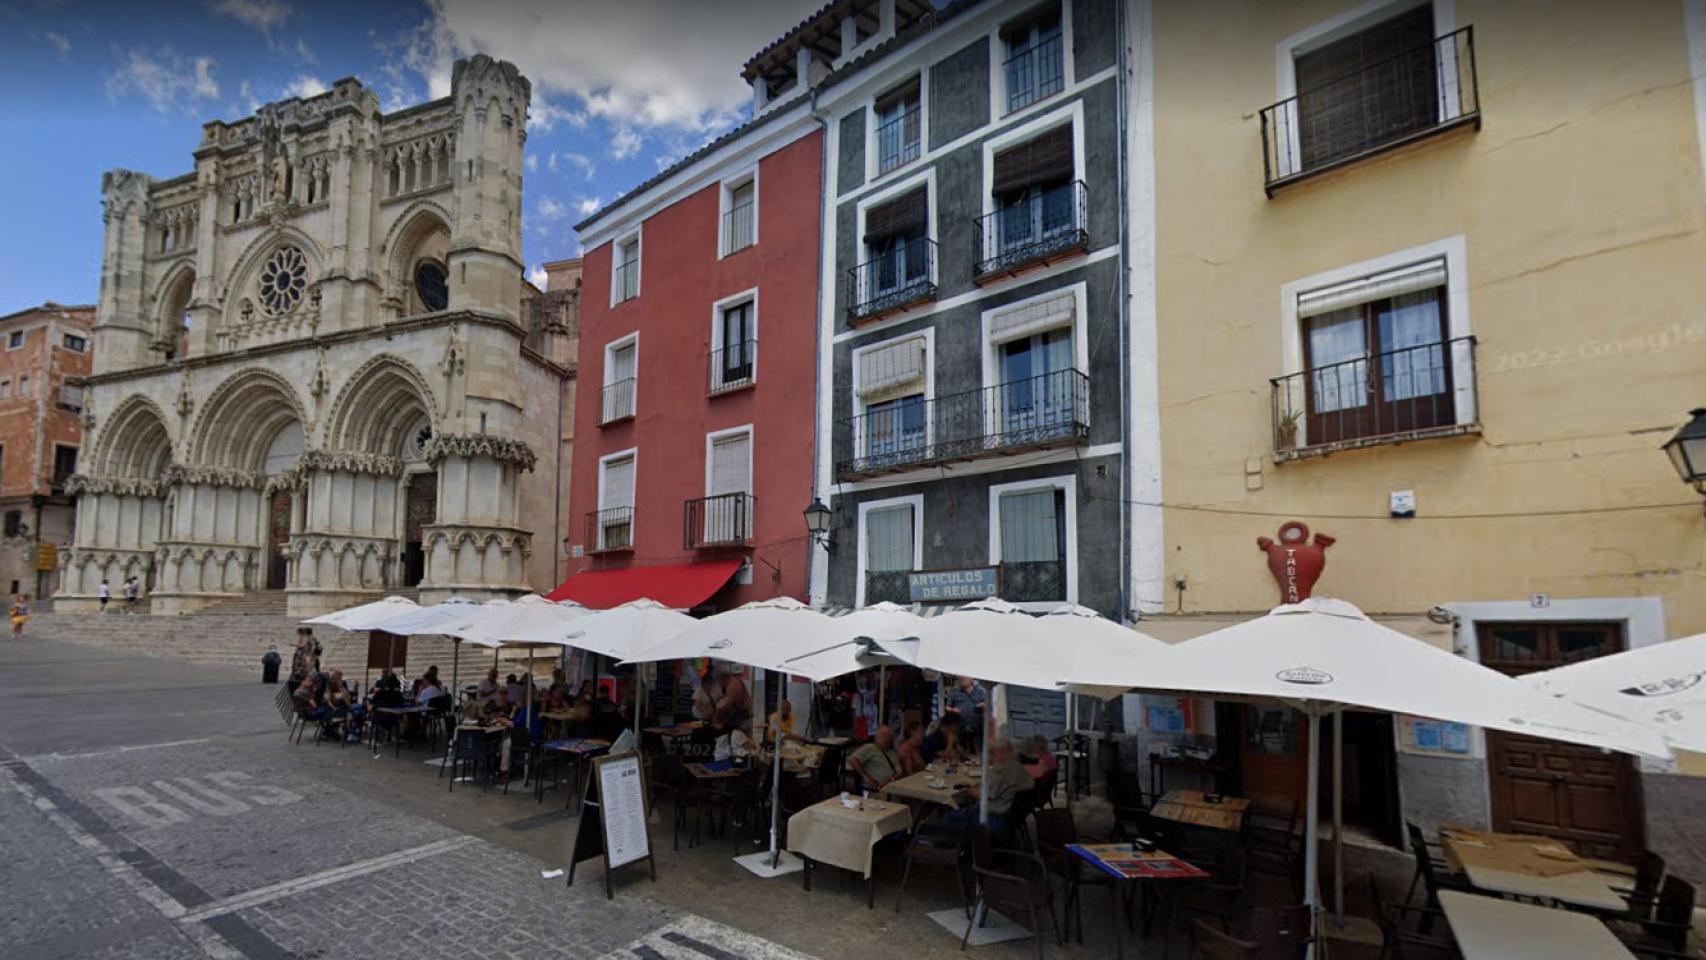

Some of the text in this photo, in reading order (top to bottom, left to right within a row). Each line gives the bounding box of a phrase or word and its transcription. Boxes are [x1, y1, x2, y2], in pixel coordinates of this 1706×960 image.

[911, 570, 983, 586] ARTICULOS
[922, 583, 996, 598] DE REGALO
[1535, 595, 1543, 606] 7
[90, 771, 304, 829] BUS
